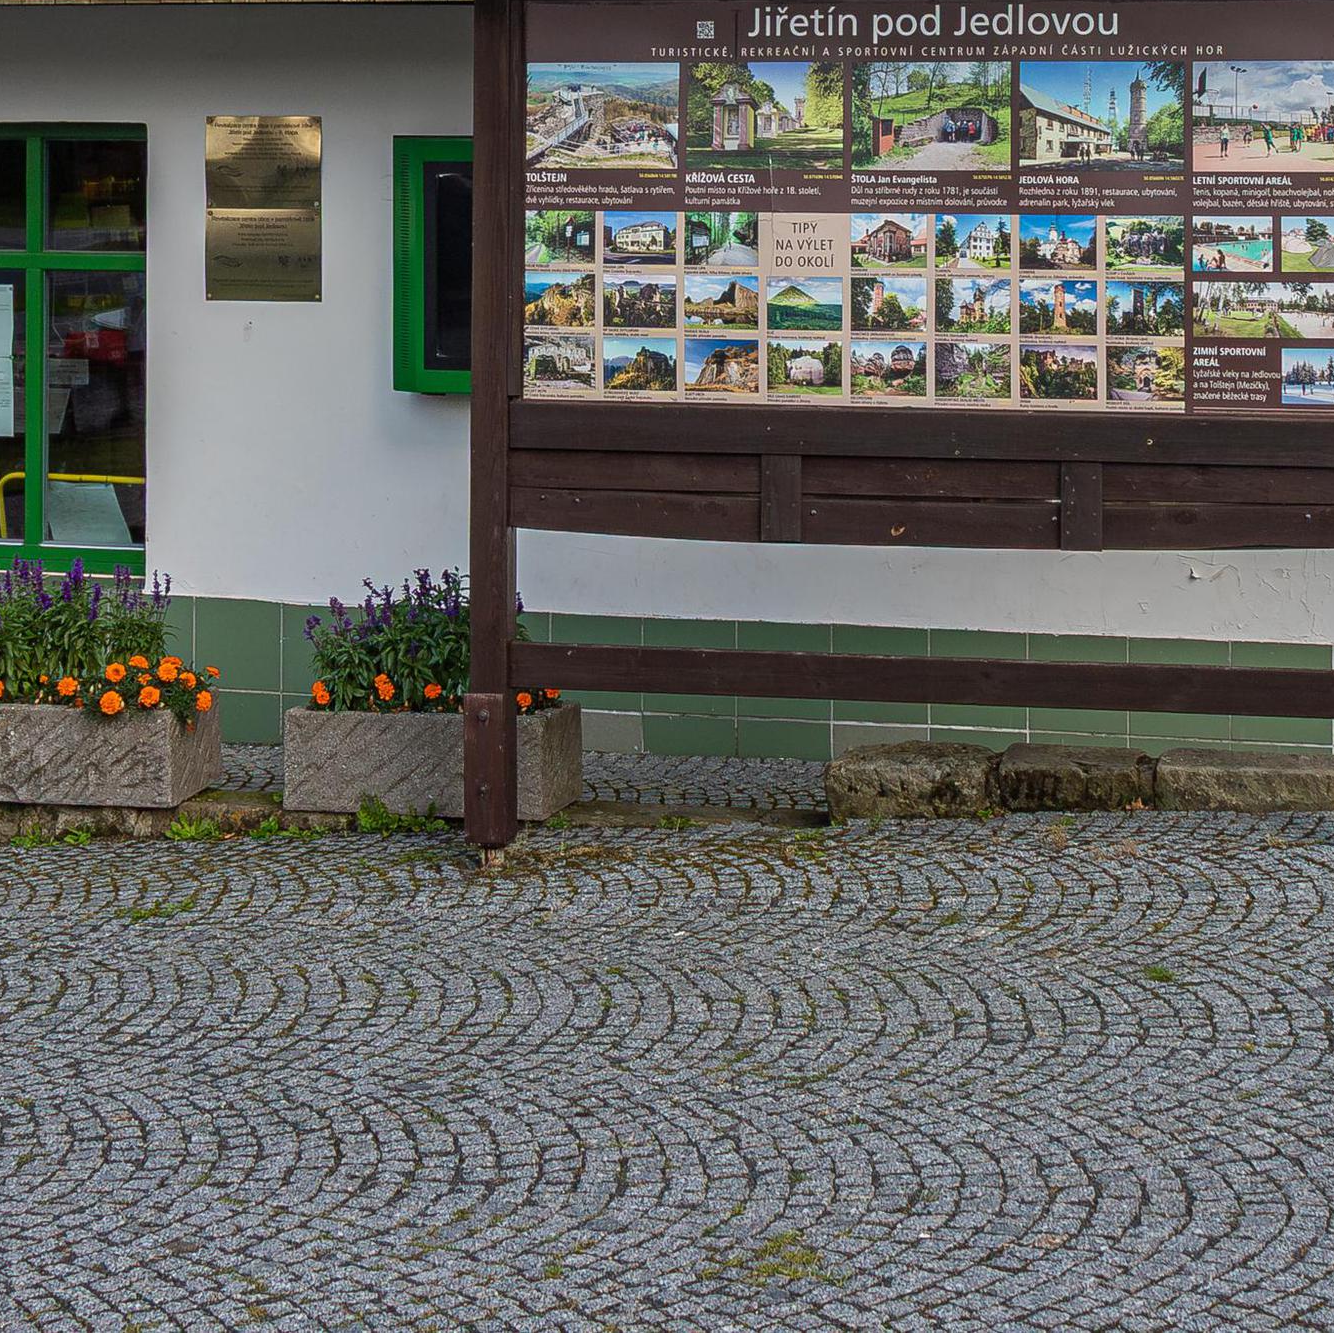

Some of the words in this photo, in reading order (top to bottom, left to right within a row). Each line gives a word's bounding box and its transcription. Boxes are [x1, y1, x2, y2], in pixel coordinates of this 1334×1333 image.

[747, 6, 858, 37] Jiřetín
[872, 4, 941, 45] pod
[953, 3, 1119, 37] Jedlovou
[650, 46, 733, 58] TURISTICKÉ,
[741, 46, 815, 57] REKREAČNÍ
[838, 45, 913, 57] SPORTOVNÍ
[921, 47, 985, 57] CENTRUM
[993, 44, 1053, 56] ZÁPADNÍ
[1061, 44, 1101, 56] ČÁSTI
[1110, 45, 1187, 56] LUŽICKÝCH
[525, 172, 567, 183] TOLŠTEJN
[685, 172, 726, 184] KŘÍŽOVÁ
[727, 174, 756, 184] CESTA
[850, 174, 876, 184] ŠTOLA
[1018, 175, 1055, 185] JEDLOVÁ
[1192, 175, 1216, 185] LETNÍ
[1265, 176, 1293, 186] AREÁL
[791, 223, 818, 234] TIPY
[796, 238, 834, 251] VÝLET
[797, 254, 834, 268] OKOLÍ
